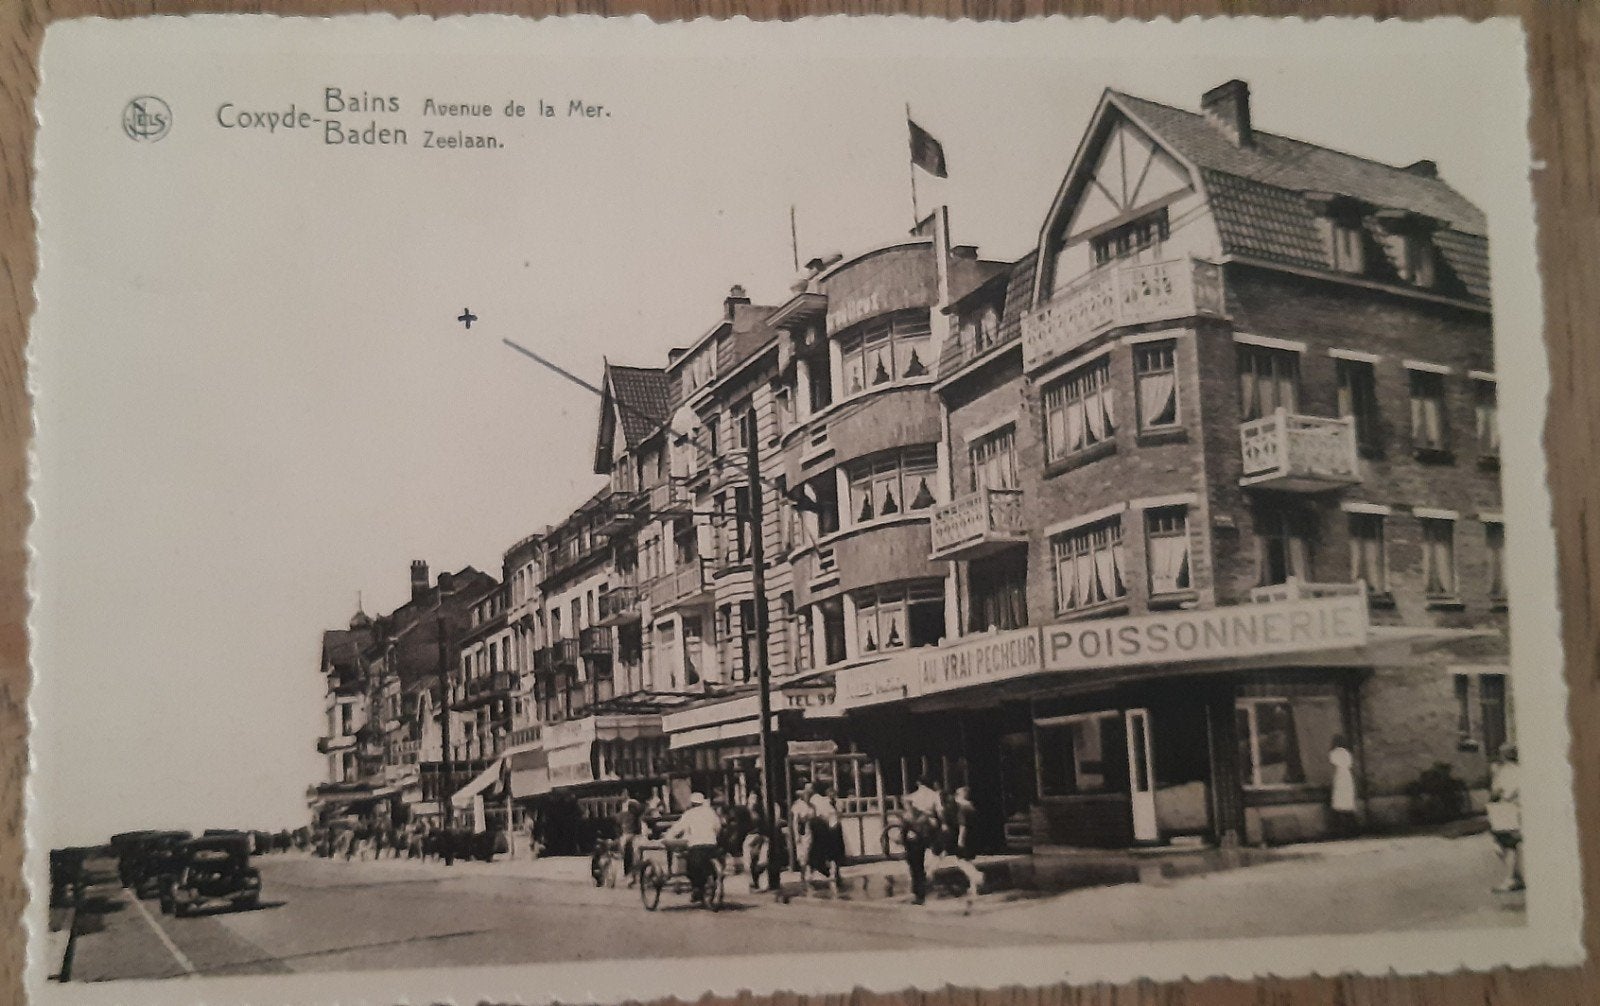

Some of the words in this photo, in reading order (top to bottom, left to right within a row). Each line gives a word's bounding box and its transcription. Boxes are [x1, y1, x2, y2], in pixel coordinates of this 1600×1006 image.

[1050, 605, 1355, 662] POISSONNERIE
[923, 660, 937, 684] AU
[941, 650, 972, 682] VRAI
